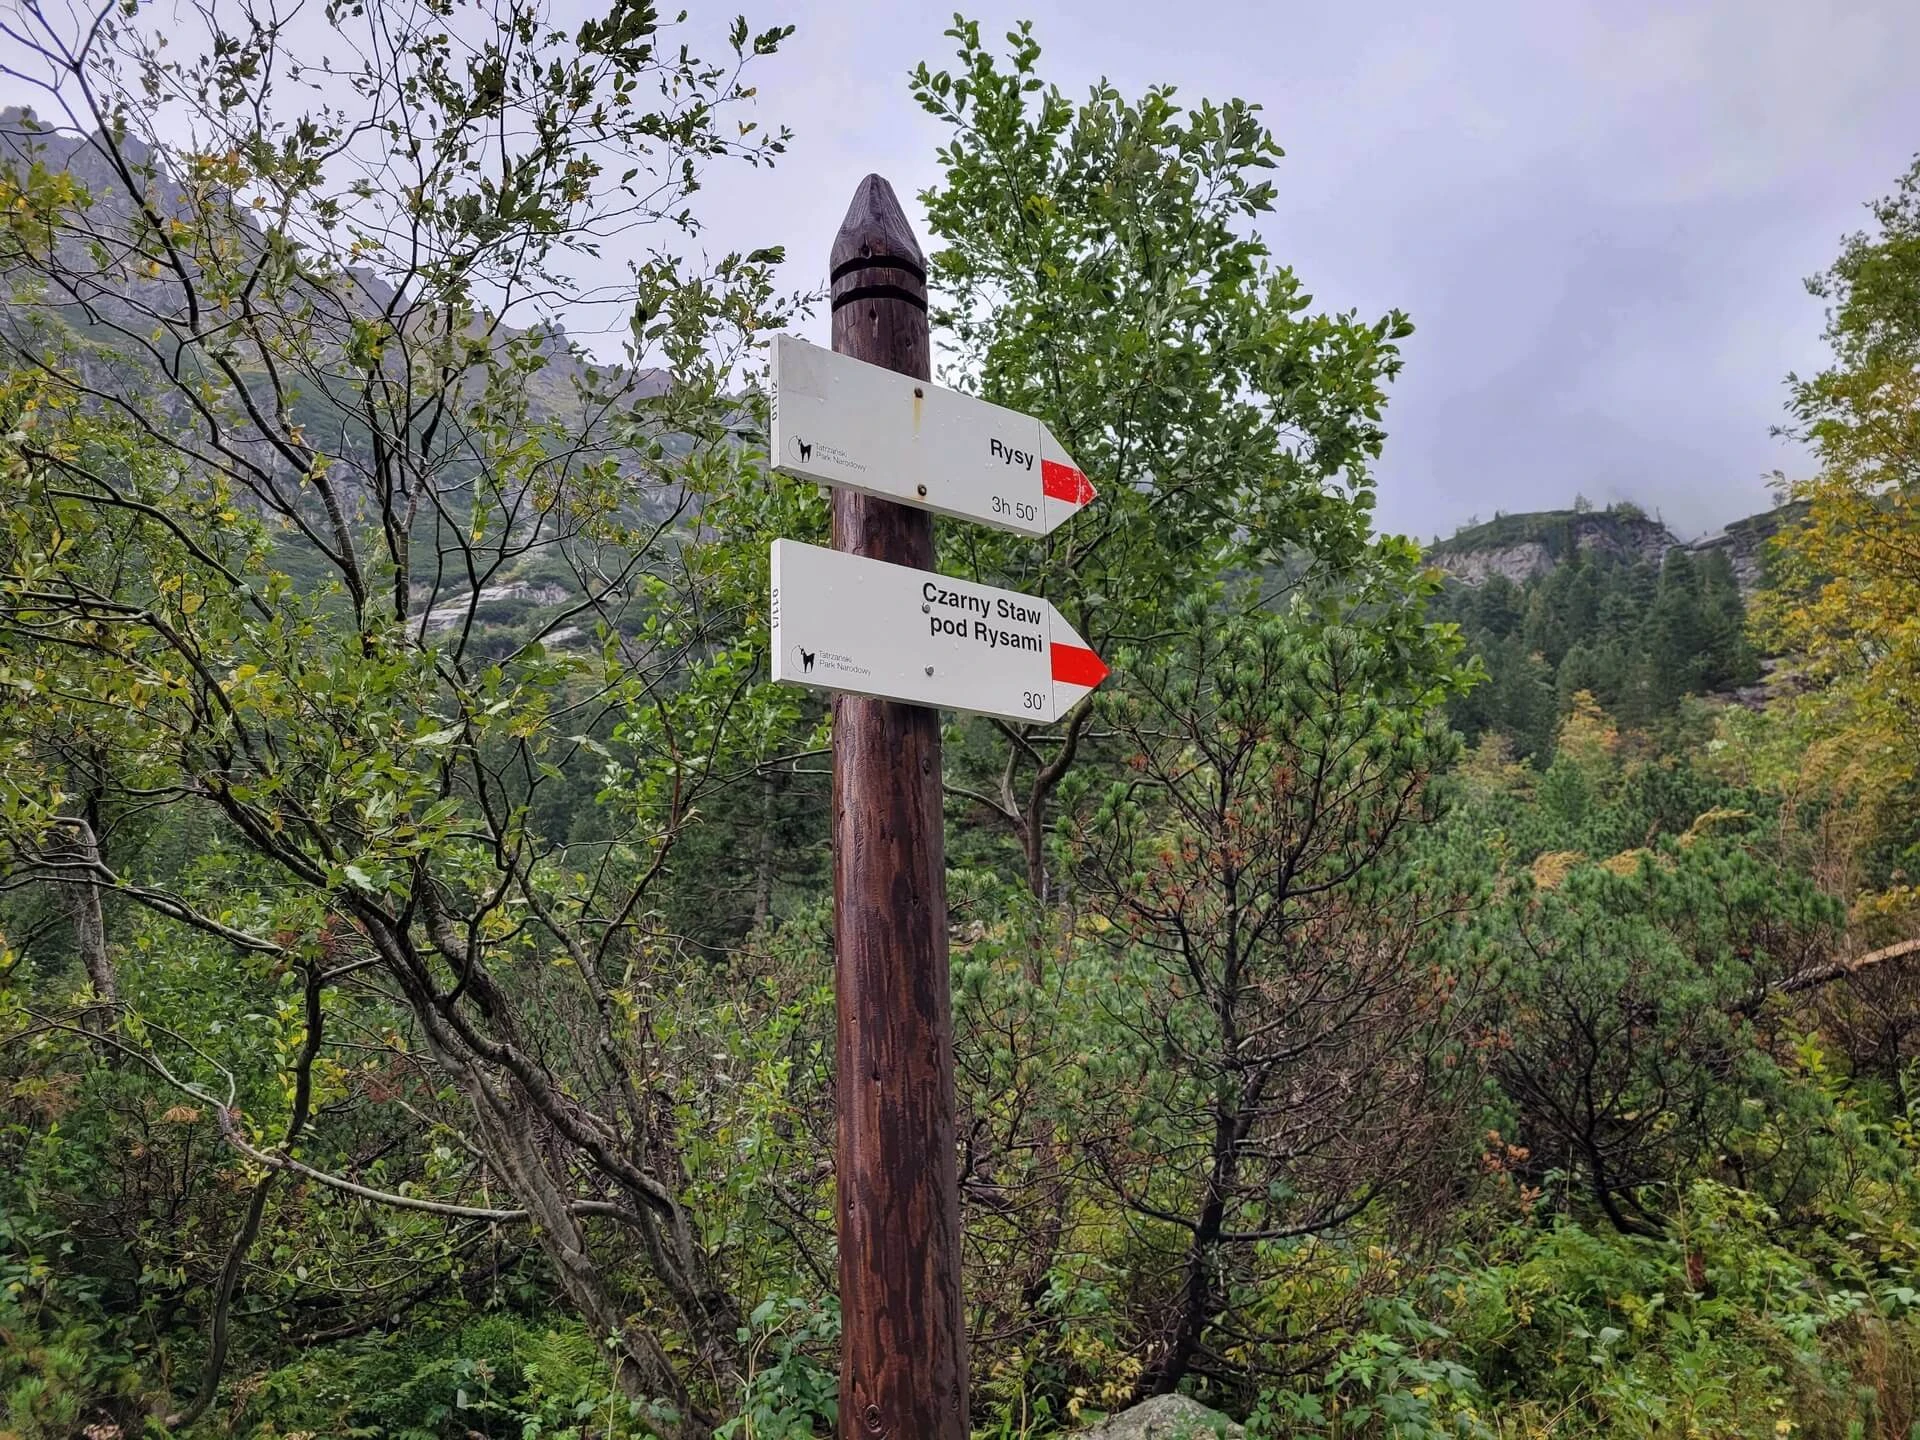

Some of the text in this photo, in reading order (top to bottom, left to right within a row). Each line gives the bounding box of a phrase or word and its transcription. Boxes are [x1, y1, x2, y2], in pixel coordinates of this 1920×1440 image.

[816, 451, 866, 473] Park Narodowy
[990, 438, 1034, 471] Rysy
[992, 496, 1011, 515] 3h
[923, 582, 1041, 625] Czarny Staw
[930, 616, 1043, 653] pod Rysami
[819, 659, 871, 678] Park Narodowy
